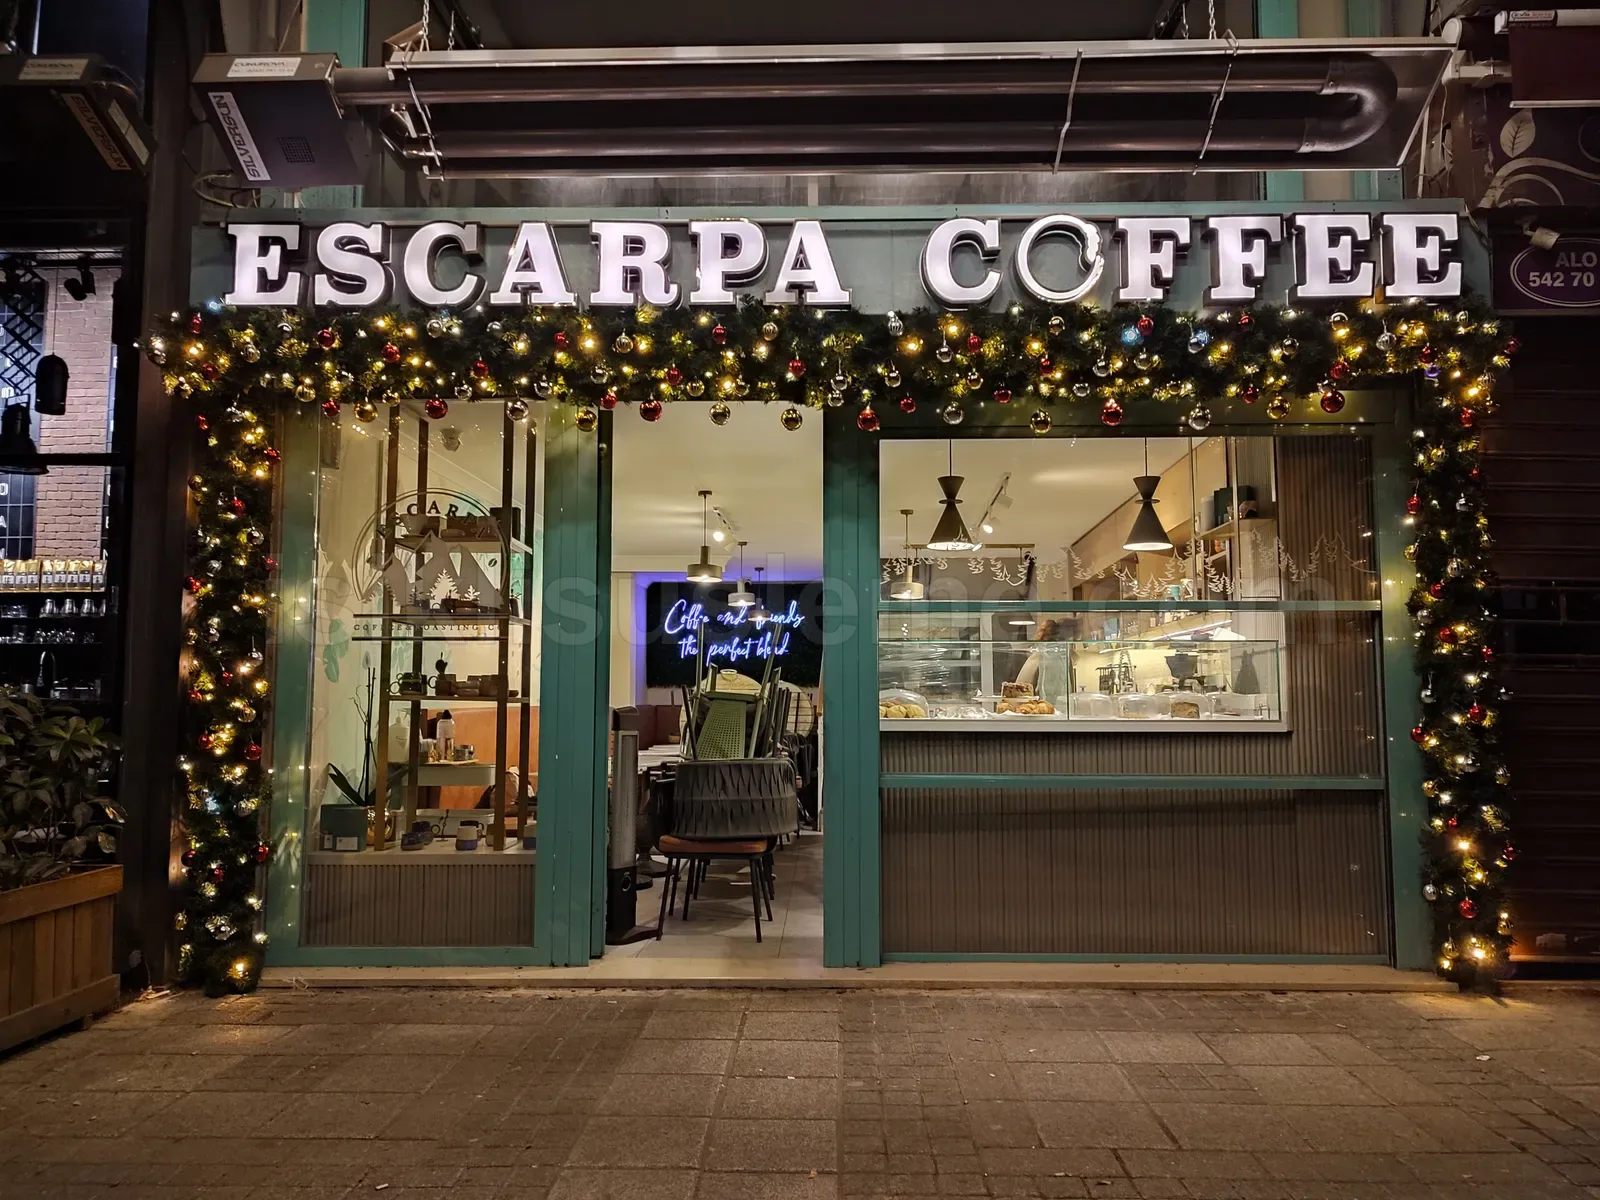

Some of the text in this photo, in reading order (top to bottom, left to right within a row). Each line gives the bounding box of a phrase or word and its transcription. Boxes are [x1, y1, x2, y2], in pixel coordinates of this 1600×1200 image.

[213, 95, 261, 179] SILVERSUN
[225, 214, 1463, 306] ESCARPA COFFEE
[1555, 251, 1598, 268] ALO
[1528, 271, 1596, 288] 542 70
[664, 598, 709, 634] Coffe
[717, 605, 747, 625] and
[678, 634, 699, 659] the
[705, 636, 754, 667] perfect
